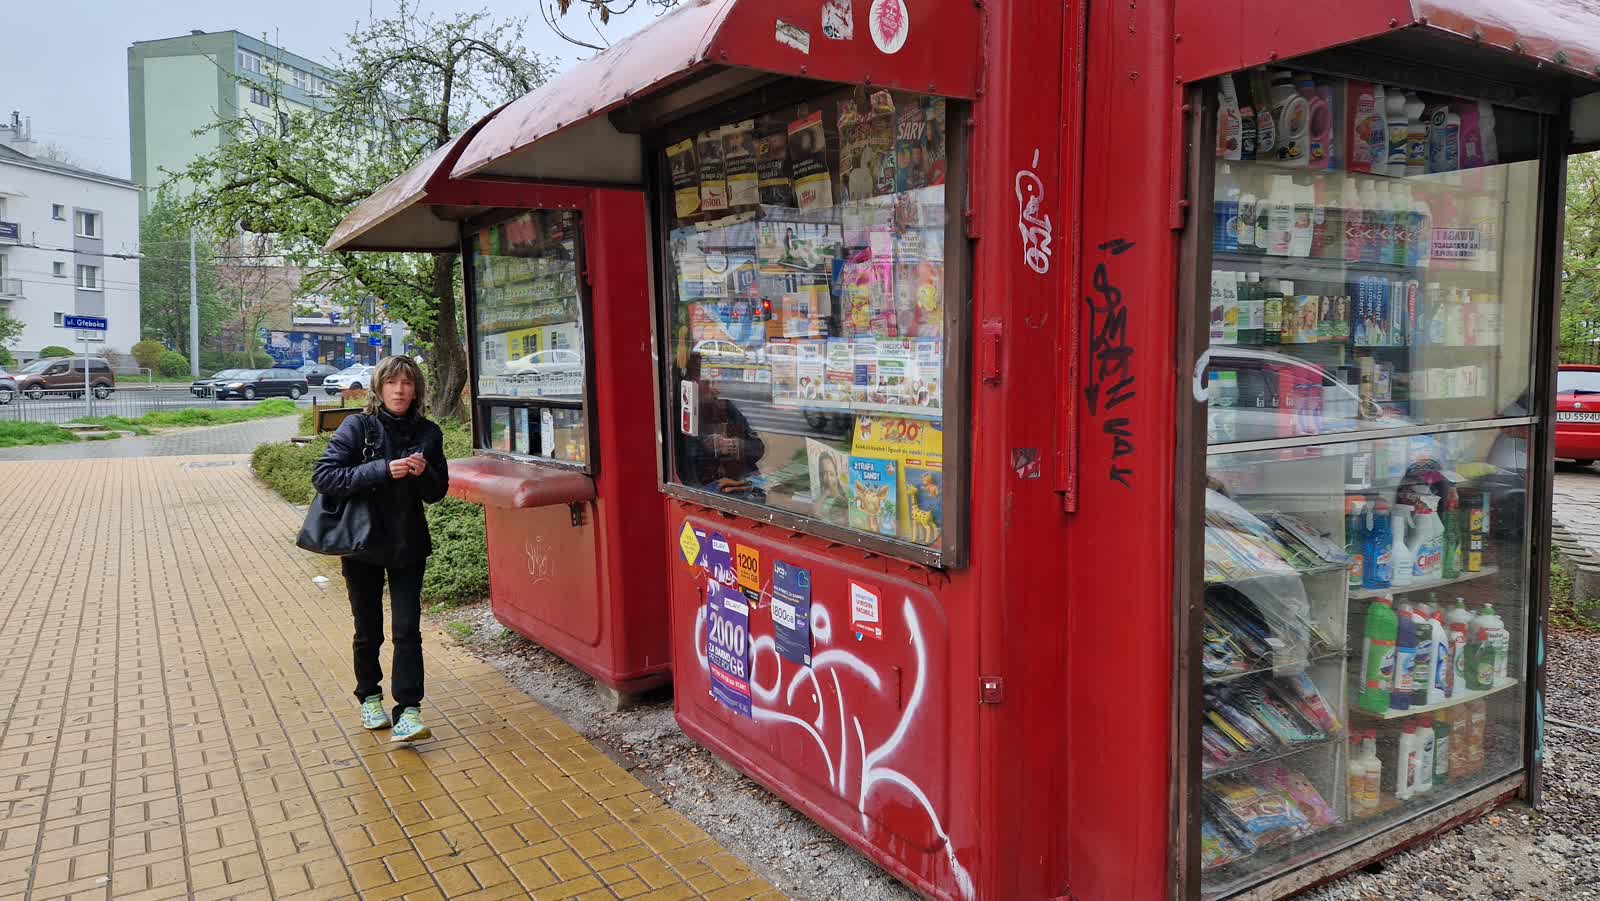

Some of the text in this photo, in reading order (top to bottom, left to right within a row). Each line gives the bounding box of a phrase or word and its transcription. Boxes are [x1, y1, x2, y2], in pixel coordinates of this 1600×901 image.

[737, 552, 758, 573] 1200
[725, 600, 741, 610] PLAY
[855, 606, 875, 617] MOBILE
[709, 611, 745, 657] 2000
[708, 642, 731, 663] ZA DARMO
[730, 656, 745, 679] GB
